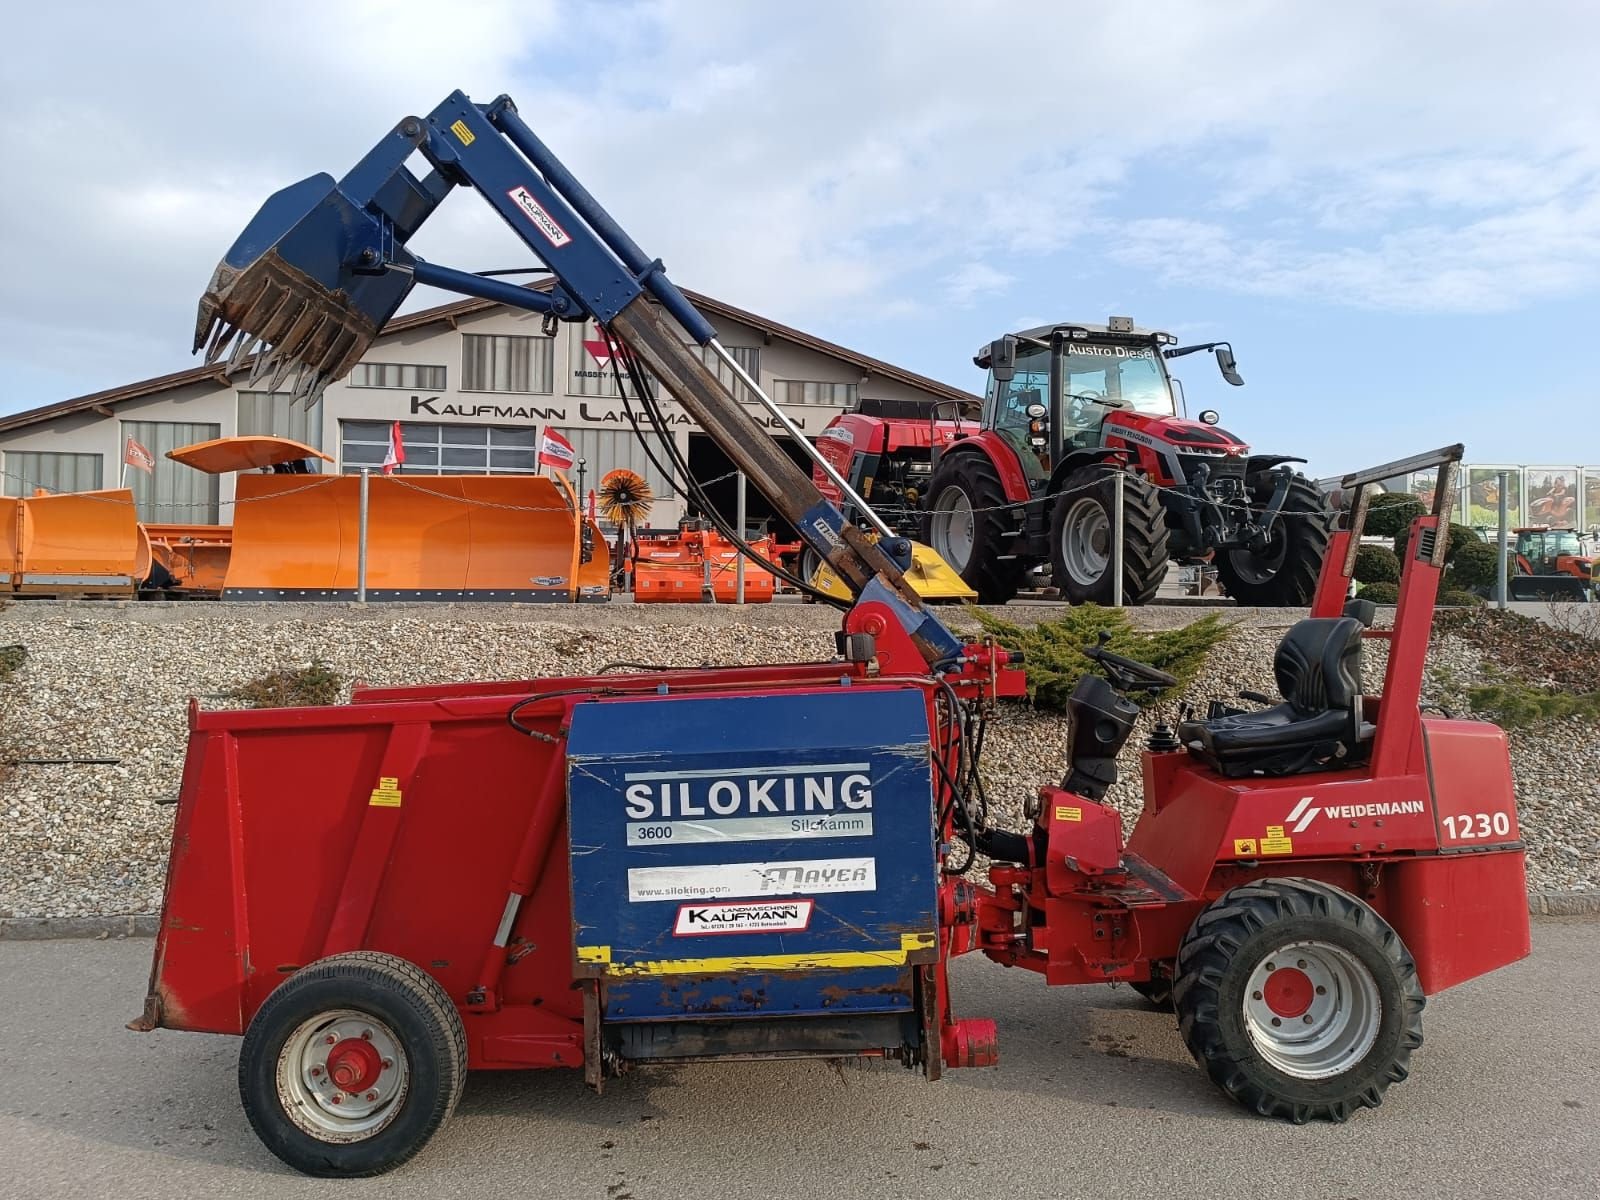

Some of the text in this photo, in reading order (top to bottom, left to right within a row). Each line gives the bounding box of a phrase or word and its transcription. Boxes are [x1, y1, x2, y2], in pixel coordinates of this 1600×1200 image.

[518, 191, 564, 240] KAUFMANN
[1068, 343, 1155, 360] Austro Diesel
[574, 370, 607, 379] MASSEY
[411, 396, 566, 421] KAUFMANN
[625, 774, 872, 818] SILOKING
[1324, 800, 1425, 819] WEIDEMANN
[637, 826, 673, 840] 3600
[1442, 811, 1510, 840] 1230
[688, 909, 797, 923] KAUFMANN
[721, 905, 797, 913] LANDMASCHINEN
